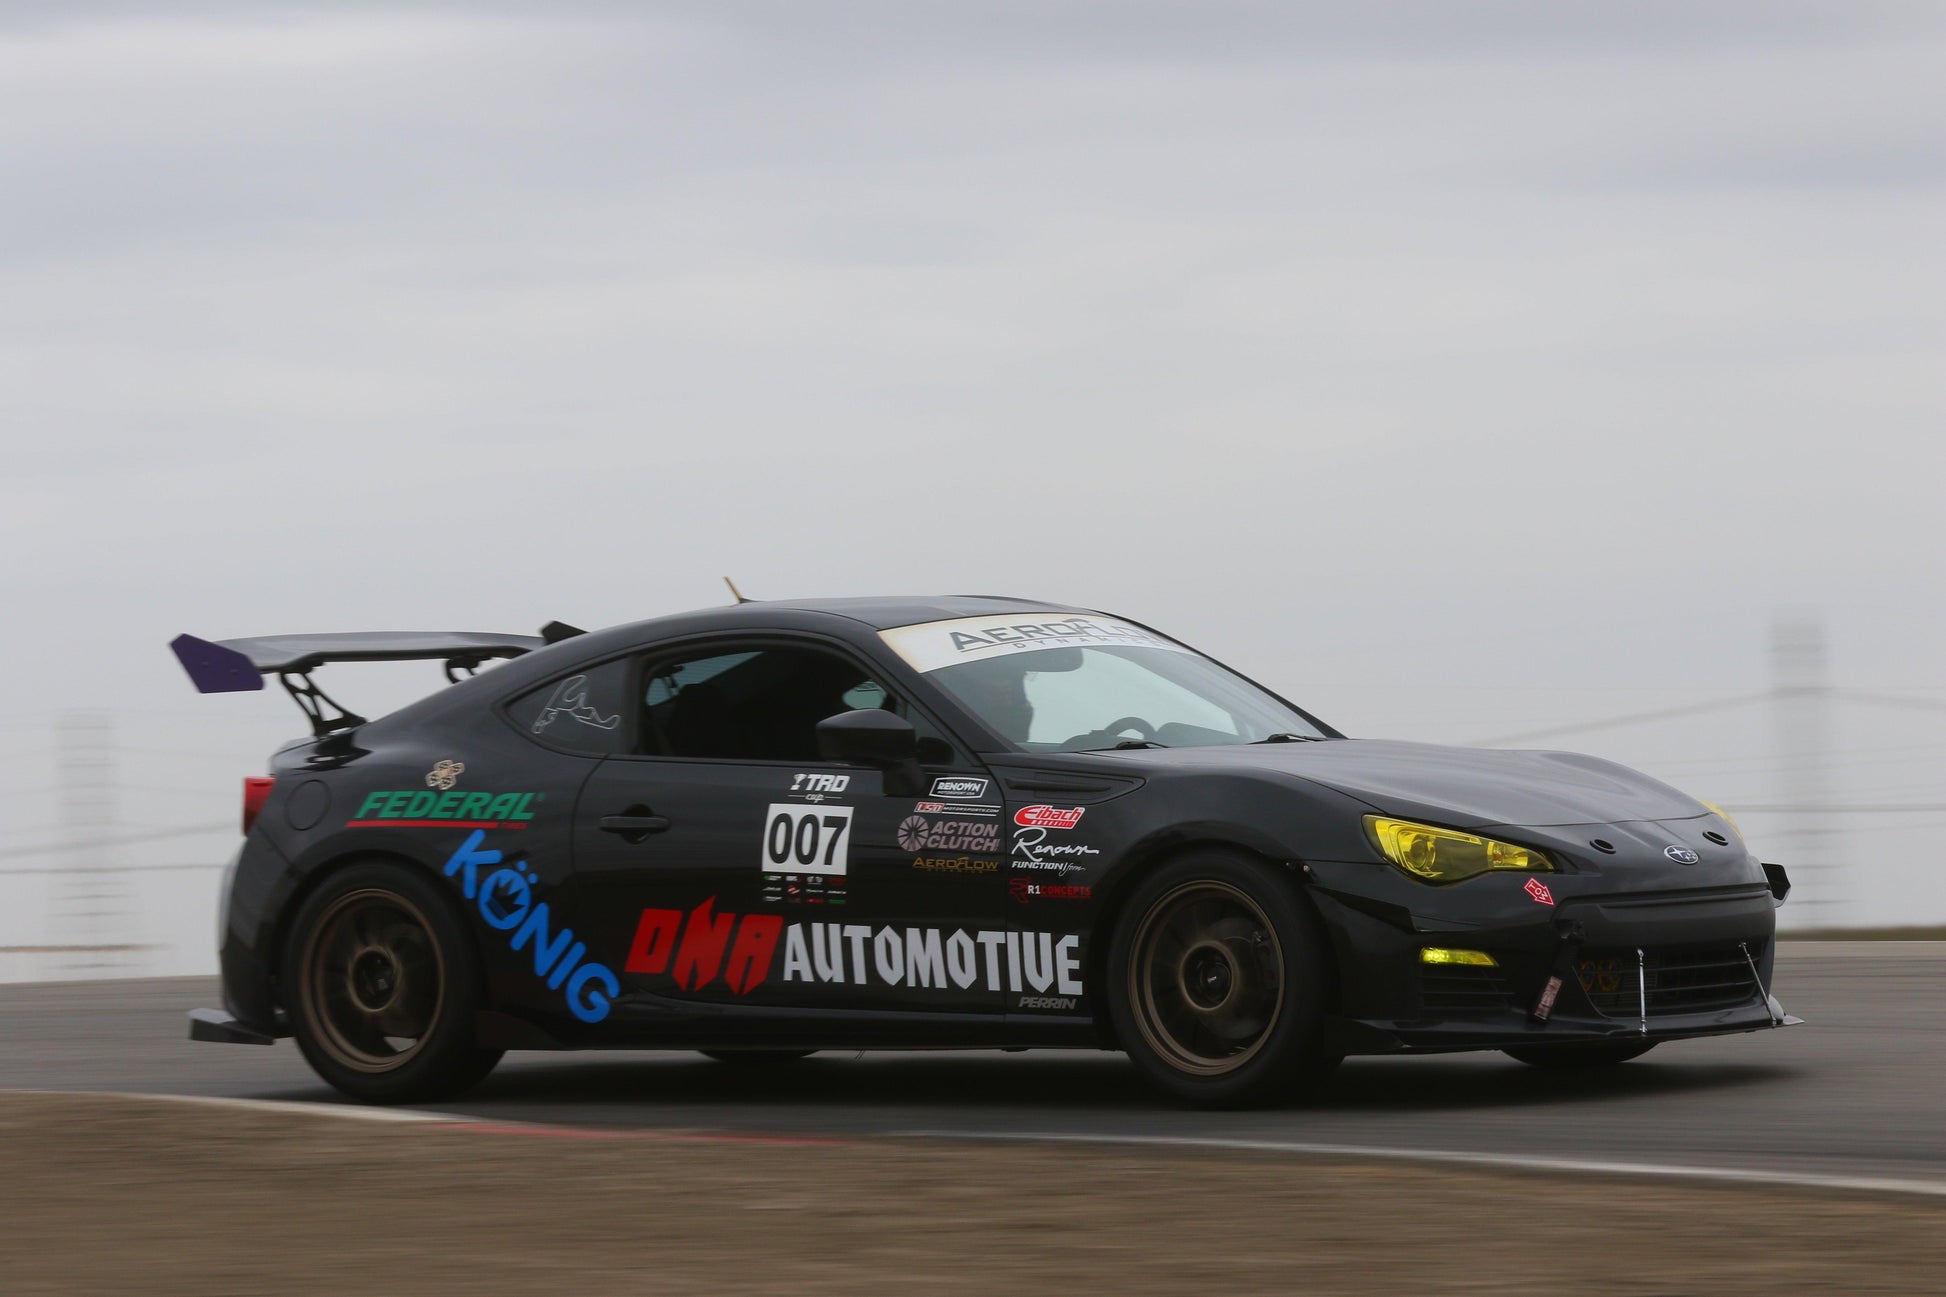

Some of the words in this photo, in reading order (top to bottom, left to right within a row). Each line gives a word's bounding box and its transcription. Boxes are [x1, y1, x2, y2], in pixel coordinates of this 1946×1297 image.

[805, 773, 851, 792] TRD
[937, 781, 982, 792] RENOWN
[353, 791, 536, 820] FEDERAL
[1014, 805, 1085, 829] Eibach
[768, 813, 849, 866] 007
[930, 821, 999, 837] ACTION
[926, 835, 1000, 851] CLUTCH
[1011, 827, 1099, 862] Renown
[1528, 882, 1549, 901] TOW
[443, 829, 620, 1023] KÖNIG
[624, 895, 784, 996] DNA
[783, 922, 1083, 996] AUTOMOTIVE
[1018, 996, 1077, 1010] PERRIN
